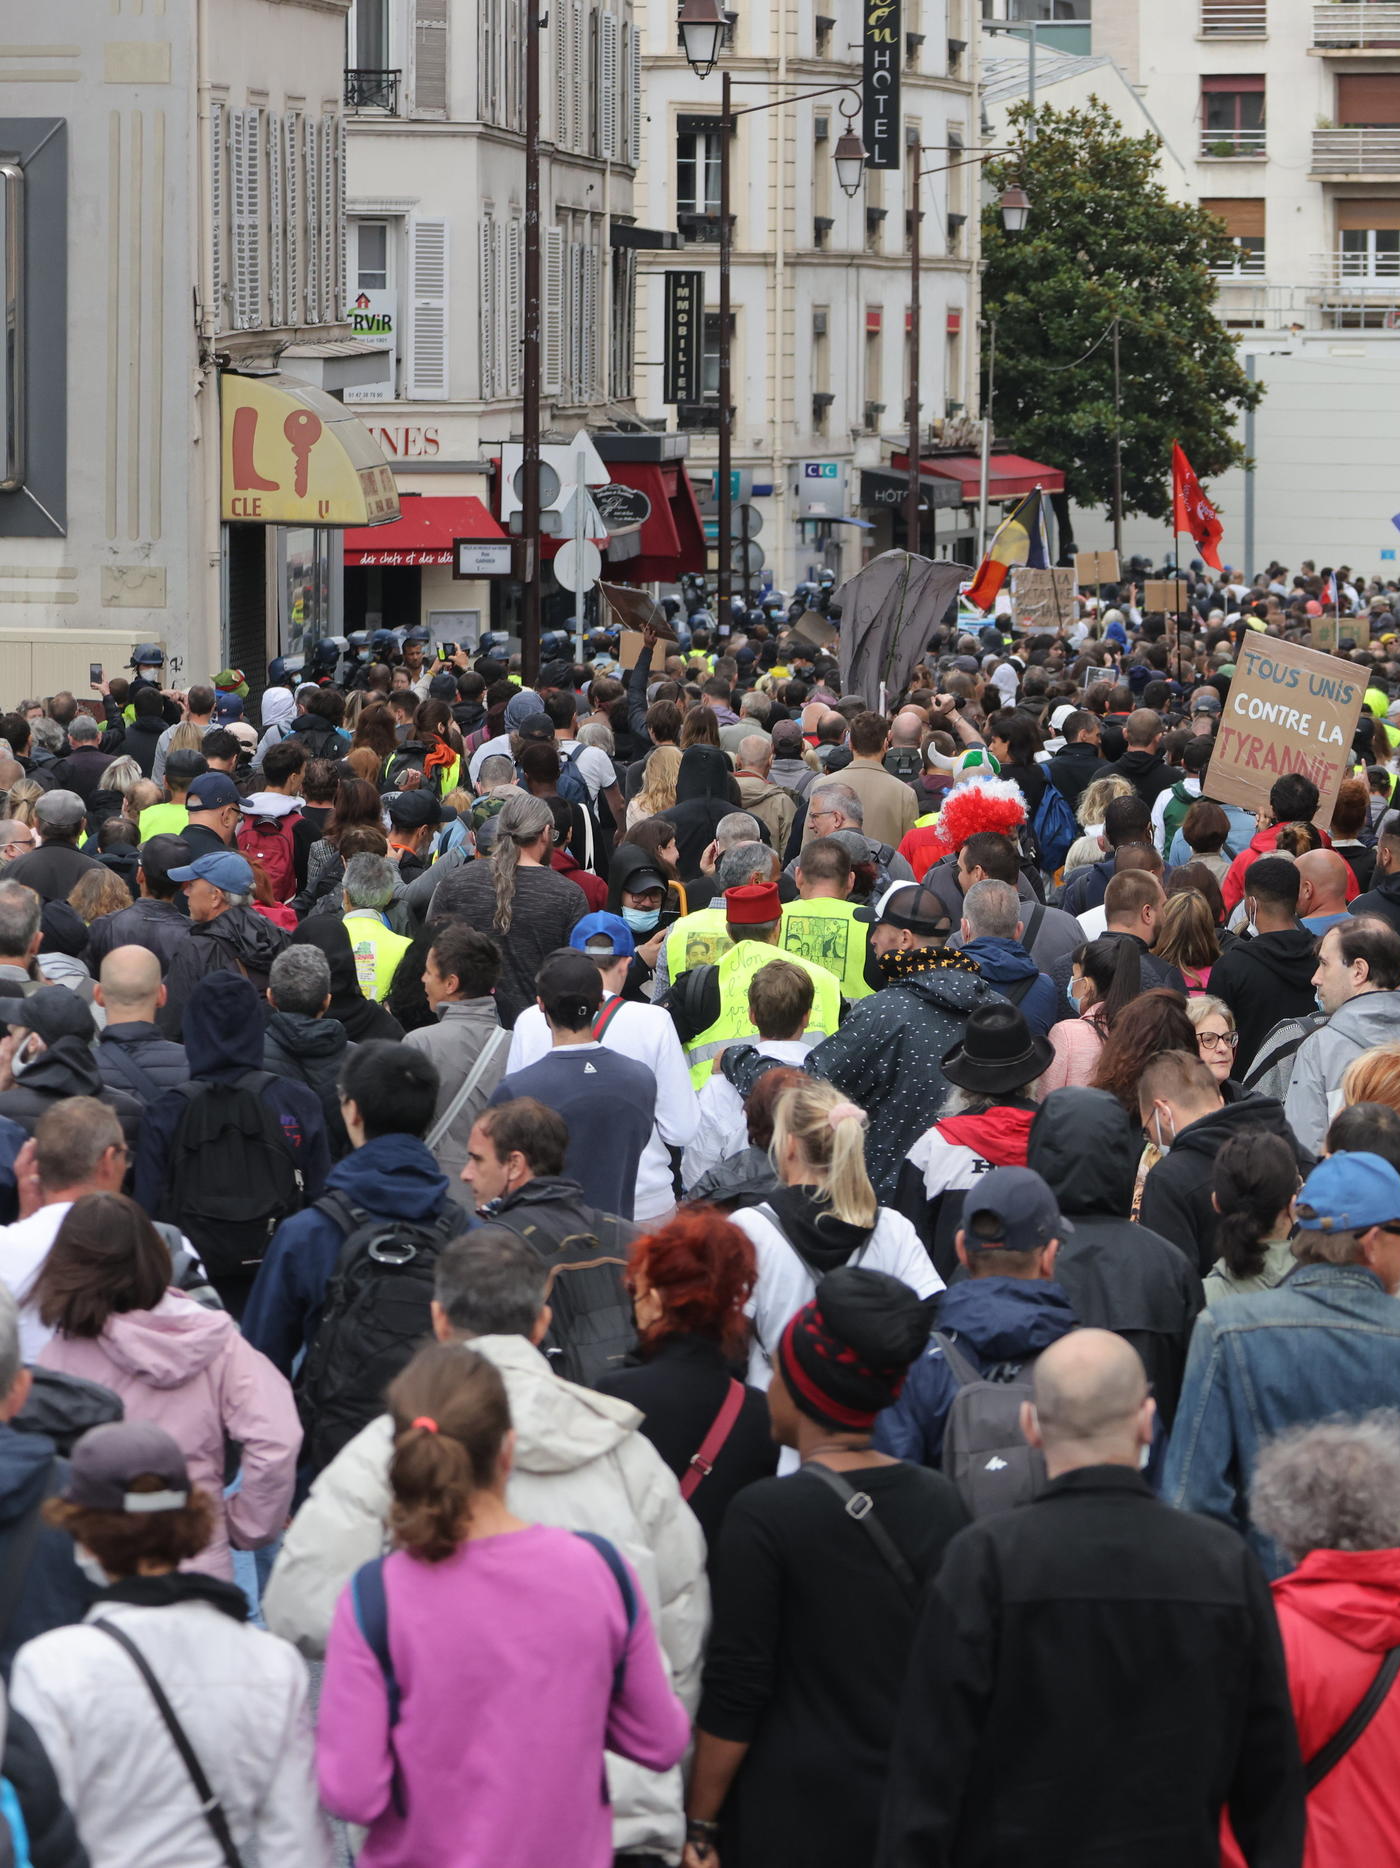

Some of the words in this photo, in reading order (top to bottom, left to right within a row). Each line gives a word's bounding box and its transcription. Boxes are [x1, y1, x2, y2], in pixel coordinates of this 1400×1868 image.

[872, 50, 891, 163] HOTEL
[676, 274, 690, 400] IMMOBILIER
[807, 465, 837, 478] CIC
[231, 497, 262, 517] CLE
[360, 553, 376, 564] des
[406, 551, 416, 564] et
[418, 553, 434, 564] des
[1244, 652, 1300, 688] TOUS
[1234, 693, 1311, 736] CONTRE
[1318, 721, 1343, 746] LA
